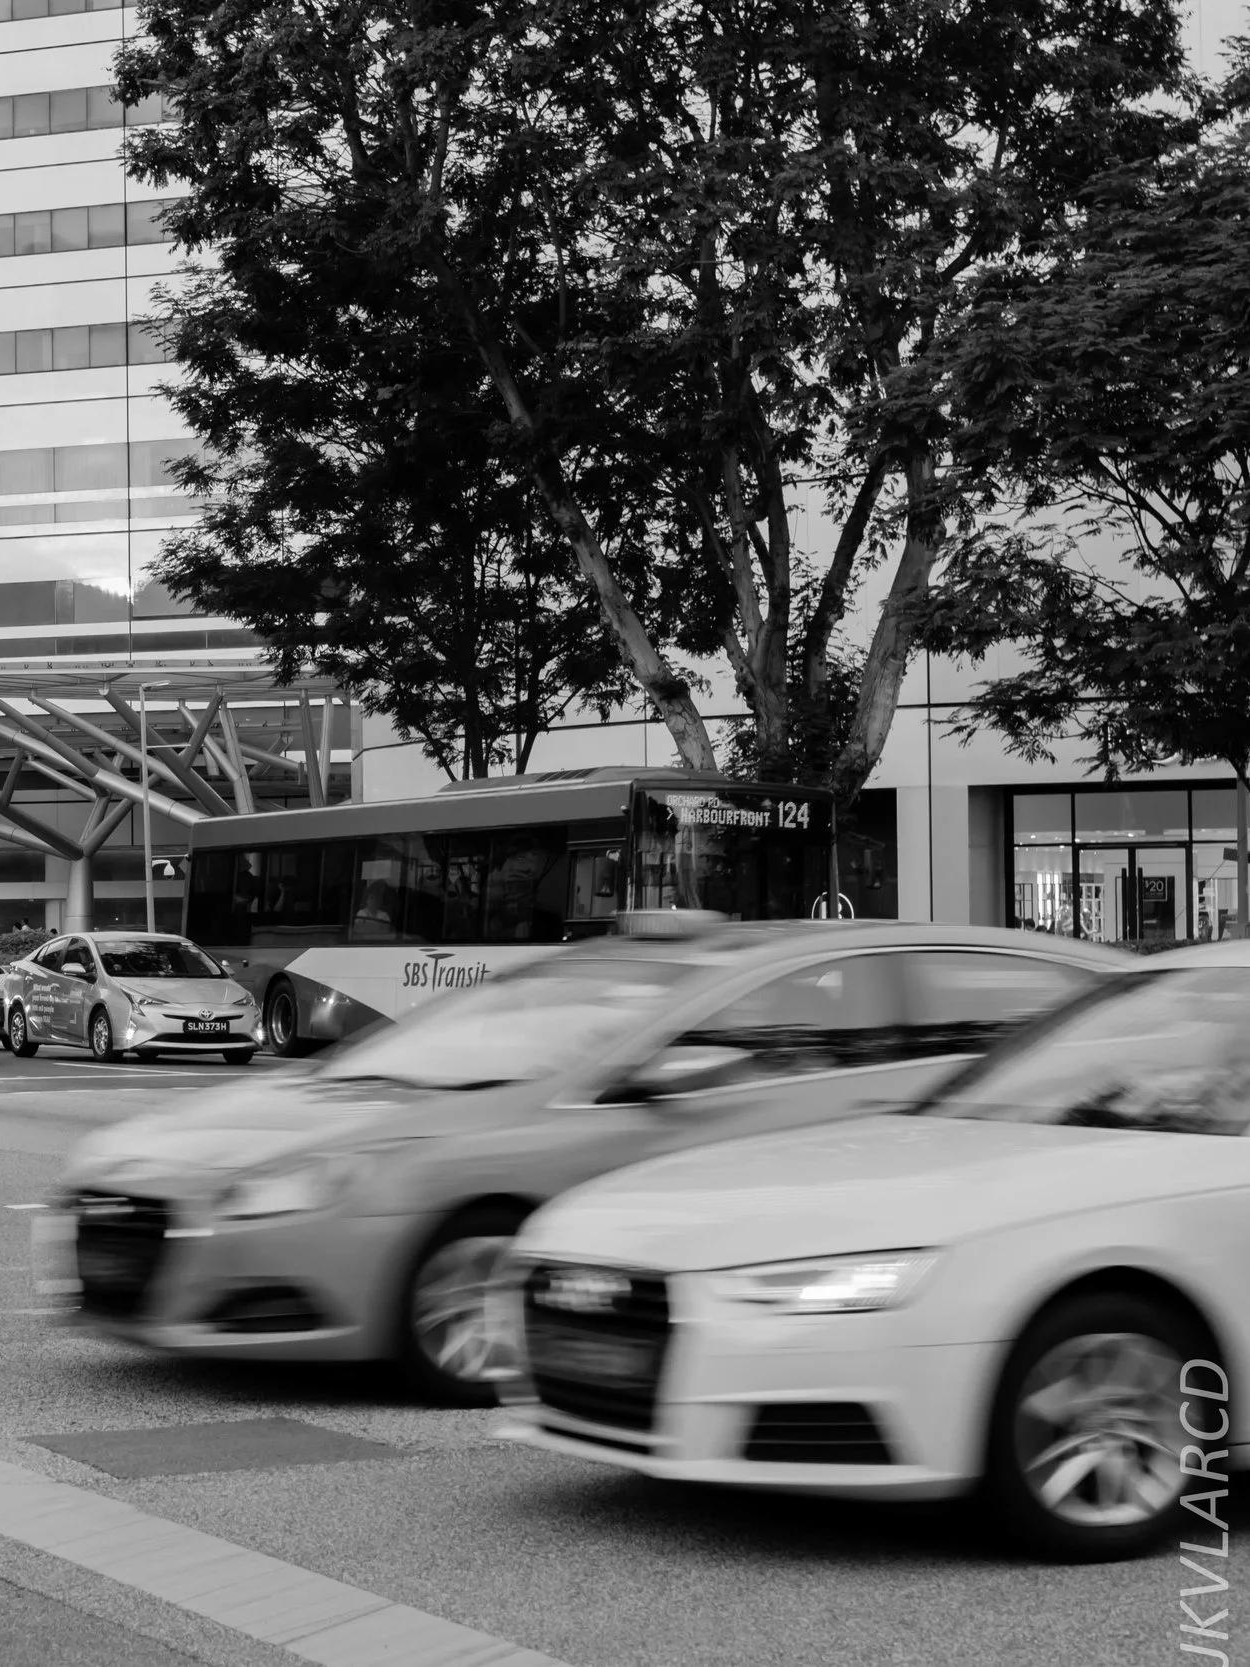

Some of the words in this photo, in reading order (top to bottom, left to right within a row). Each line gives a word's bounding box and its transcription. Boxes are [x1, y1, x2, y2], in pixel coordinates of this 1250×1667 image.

[680, 807, 771, 827] HARBOURFRONT
[778, 801, 810, 829] 124
[402, 961, 429, 987] SBS
[425, 953, 492, 992] Transit
[187, 1022, 227, 1031] SLN373H
